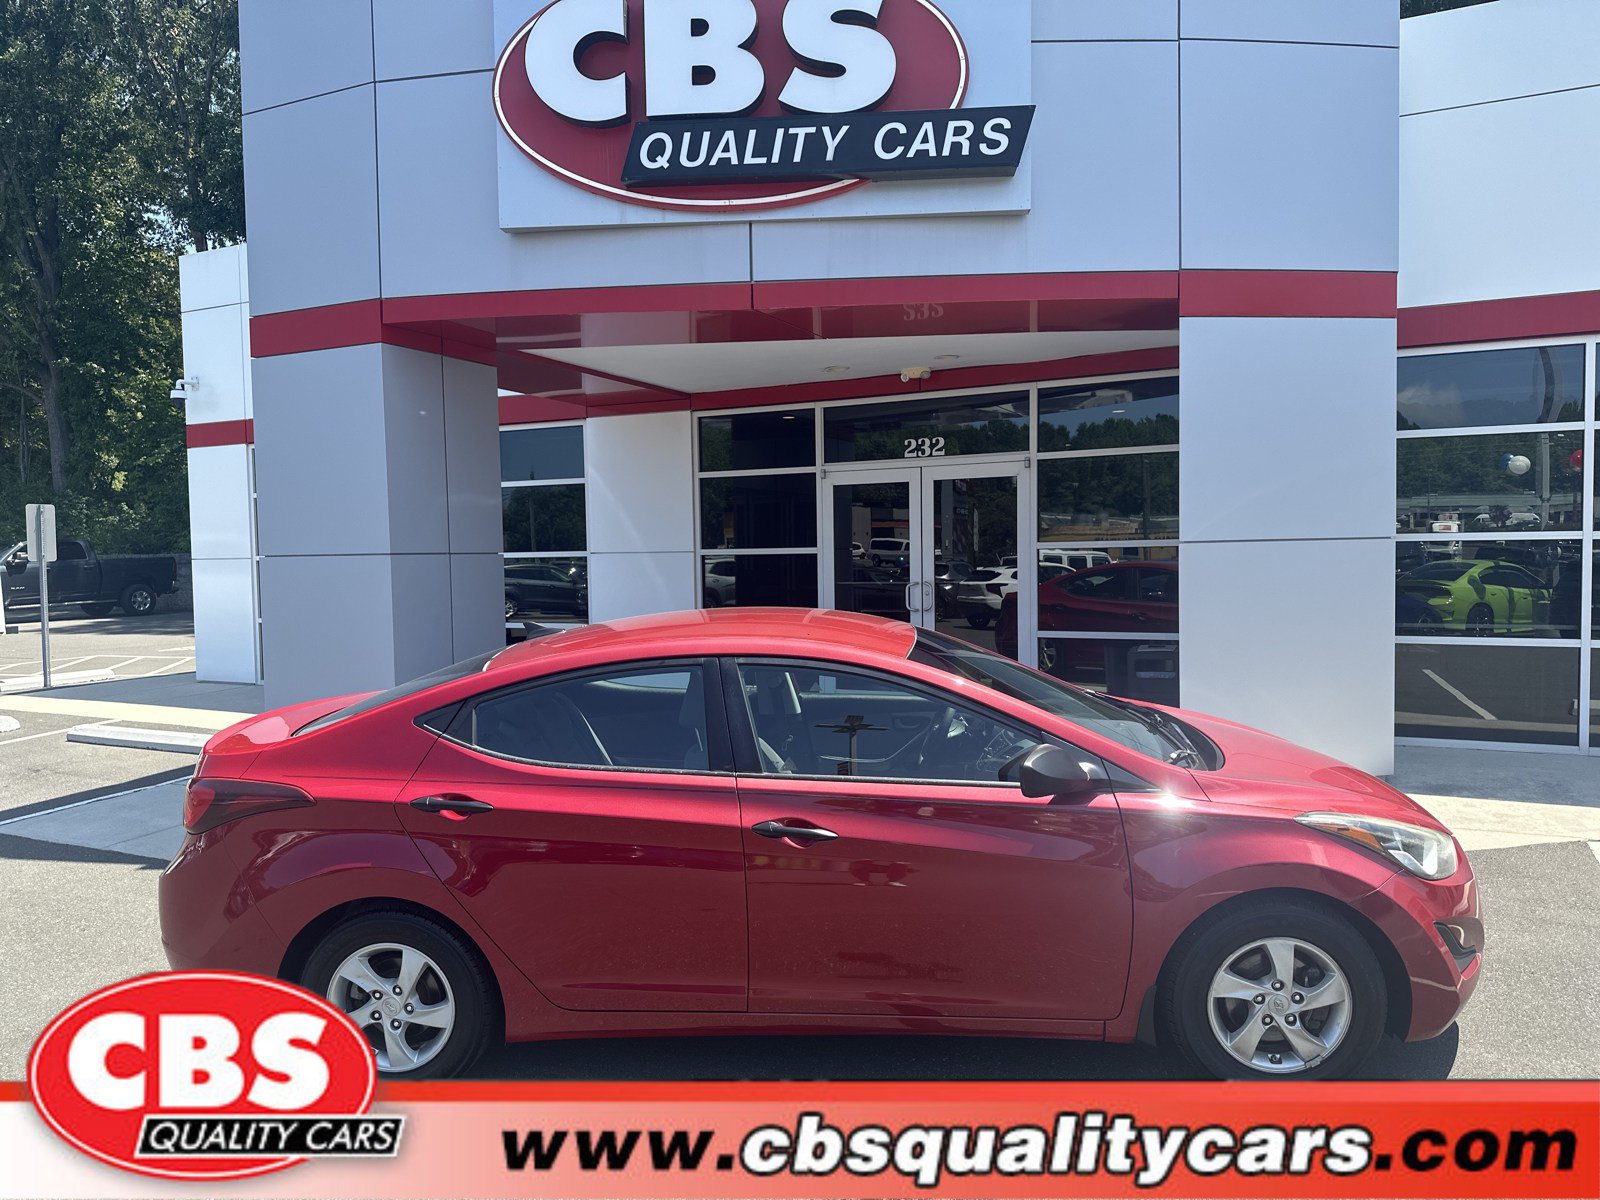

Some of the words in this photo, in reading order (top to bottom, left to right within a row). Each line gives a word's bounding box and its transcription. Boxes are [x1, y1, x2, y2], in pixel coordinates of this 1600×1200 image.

[524, 0, 897, 122] CBS
[639, 125, 850, 170] QUALITY
[874, 117, 1011, 161] CARS
[904, 436, 945, 458] 232
